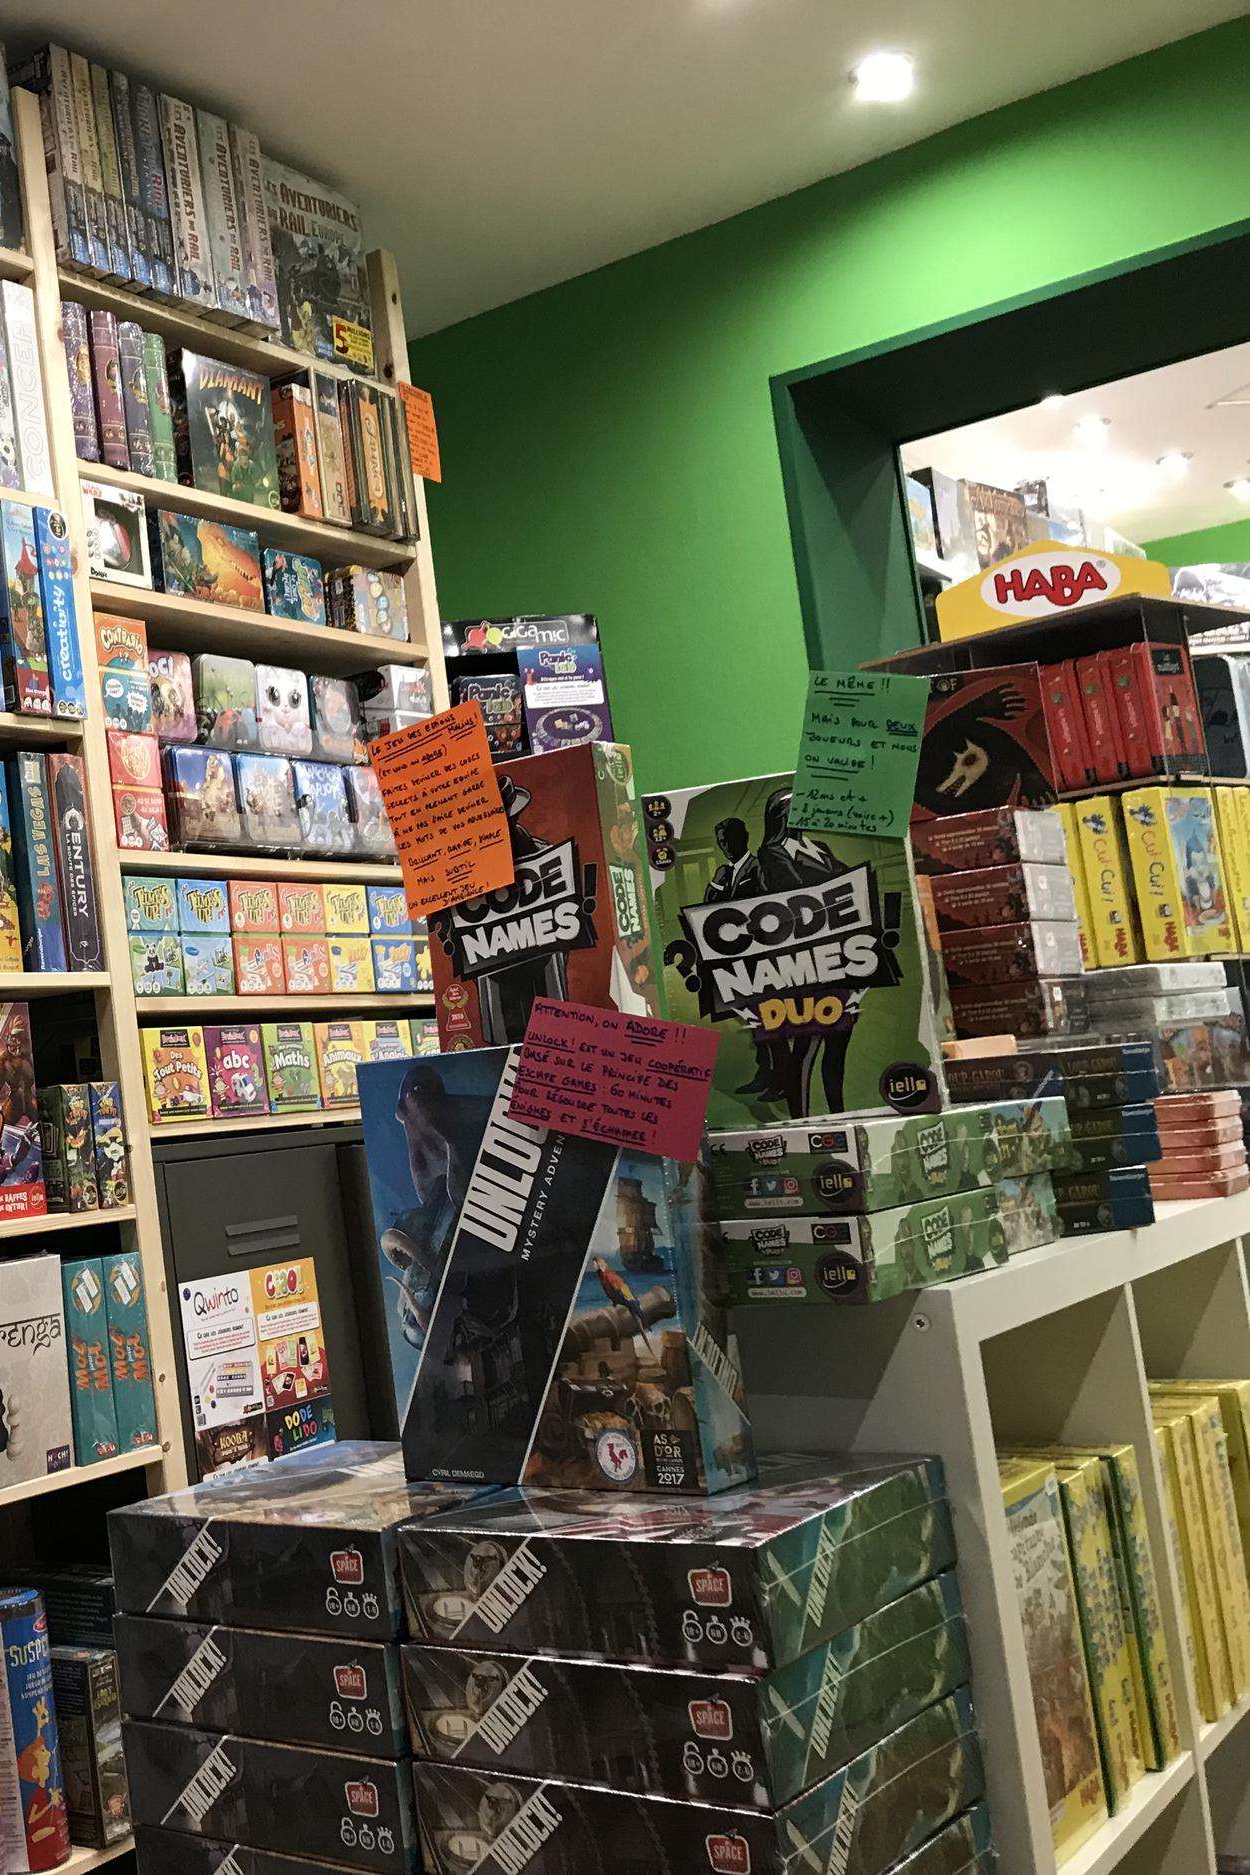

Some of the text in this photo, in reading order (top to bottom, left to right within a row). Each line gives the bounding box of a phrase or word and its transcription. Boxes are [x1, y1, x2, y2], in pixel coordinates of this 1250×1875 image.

[174, 124, 200, 262] AVENTURIERS RAIL
[215, 141, 241, 273] AVENTURIERS RAIL
[279, 183, 359, 233] AVENTURIERS
[277, 206, 311, 237] RAIL
[335, 322, 349, 354] 5
[198, 366, 265, 405] DIAMANT
[994, 561, 1108, 607] HABA
[100, 626, 143, 657] CONTRARIO
[814, 676, 828, 686] LE
[806, 731, 861, 748] JOUEURS
[871, 741, 886, 750] ET
[886, 719, 917, 732] DEUX
[805, 755, 819, 763] ON
[28, 785, 49, 878] LAS VEGAS
[62, 806, 89, 919] CENTURY
[66, 846, 74, 872] ROUTE
[609, 863, 625, 936] CODE
[625, 868, 641, 934] NAMES
[460, 902, 581, 965] NAMES
[702, 892, 864, 957] CODE
[712, 932, 880, 1003] NAMES
[757, 996, 845, 1028] DUO
[602, 1021, 619, 1030] ON
[627, 1020, 669, 1039] ADORE
[223, 1051, 250, 1070] abc
[274, 1050, 310, 1068] Maths
[554, 1057, 576, 1068] SUR
[581, 1062, 594, 1073] LE
[656, 1077, 679, 1092] DES
[579, 1043, 713, 1078] EST UN JEU COOPÉRATIF
[562, 1077, 597, 1093] GAMES
[888, 1076, 928, 1095] iello
[560, 1112, 577, 1123] ET
[602, 1104, 636, 1120] TOUTES
[641, 1111, 658, 1125] LES
[521, 1134, 566, 1261] MYSTERY ADVEN
[194, 1287, 239, 1317] Qwinto
[654, 1434, 667, 1447] AS
[655, 1465, 685, 1474] CANNES
[658, 1472, 685, 1485] 2017
[164, 1526, 223, 1606] UNLOCK!
[335, 1556, 361, 1575] SPACE
[473, 1545, 549, 1634] UNLOCK!
[696, 1577, 726, 1595] SPACE
[170, 1640, 228, 1716] UNLOCK!
[337, 1673, 363, 1689] SPACE
[696, 1709, 726, 1726] SPACE
